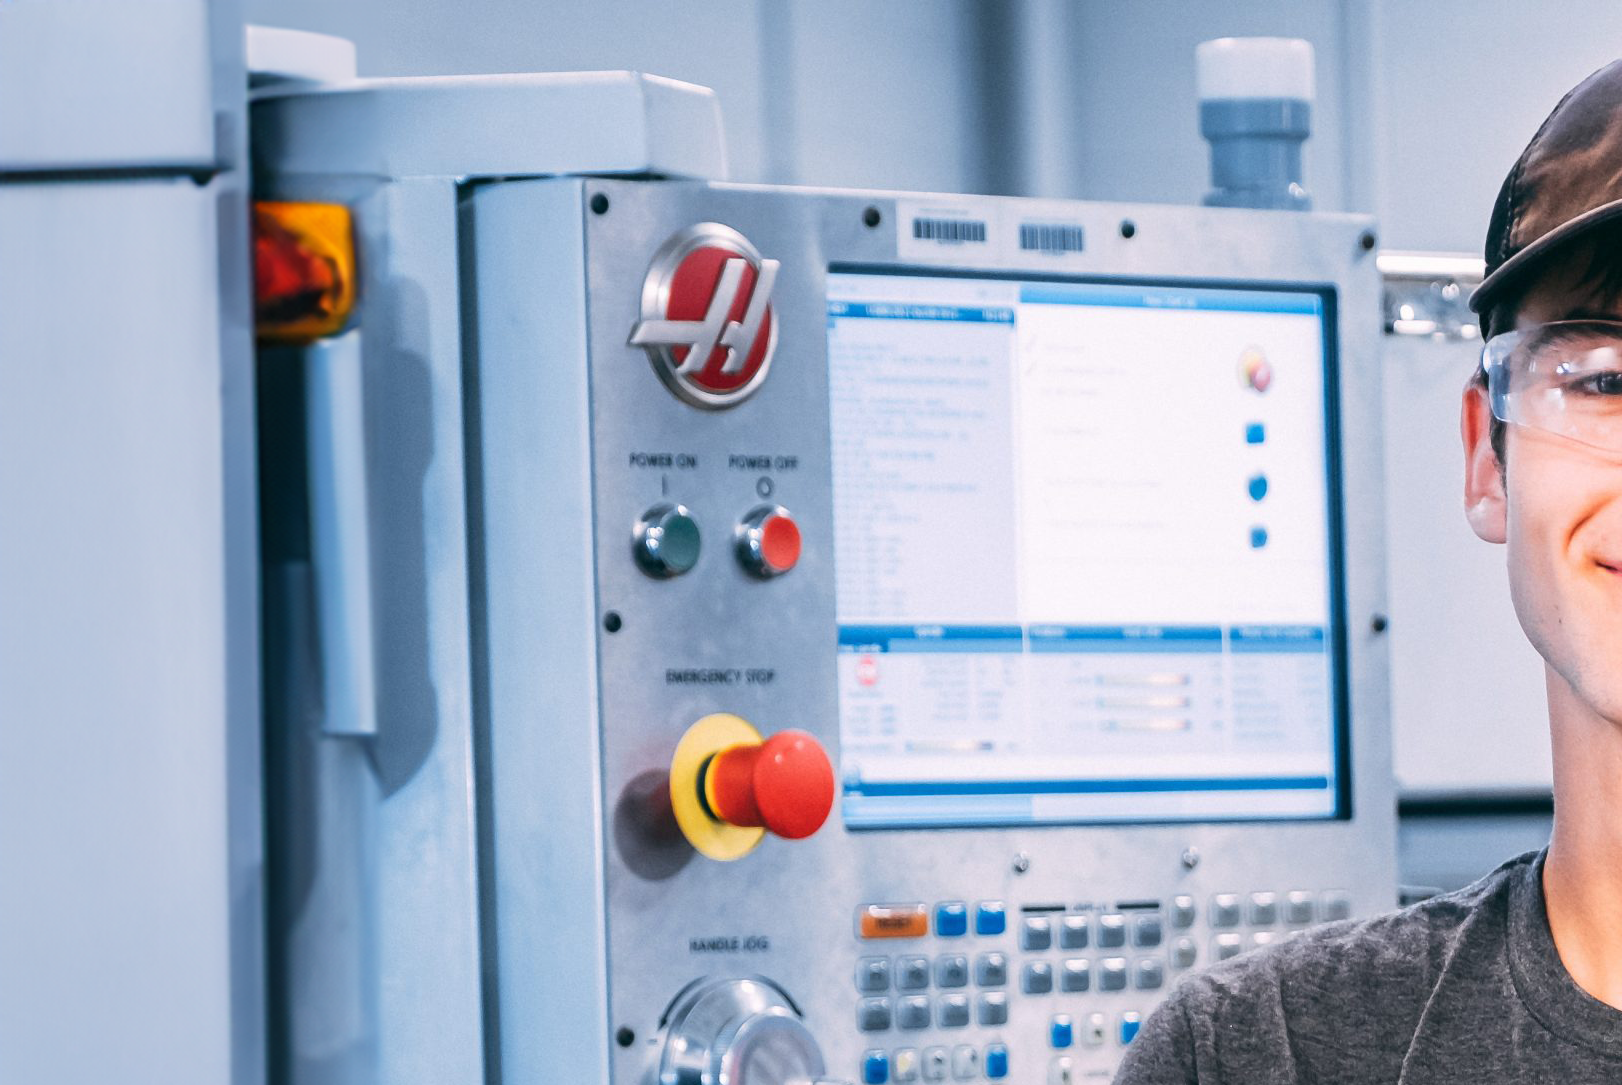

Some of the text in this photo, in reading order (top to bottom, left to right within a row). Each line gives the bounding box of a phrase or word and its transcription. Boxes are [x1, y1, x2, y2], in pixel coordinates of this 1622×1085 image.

[629, 453, 697, 469] POWER ON
[728, 454, 799, 471] POWER OFF
[665, 668, 774, 685] EMERGENCY STOP
